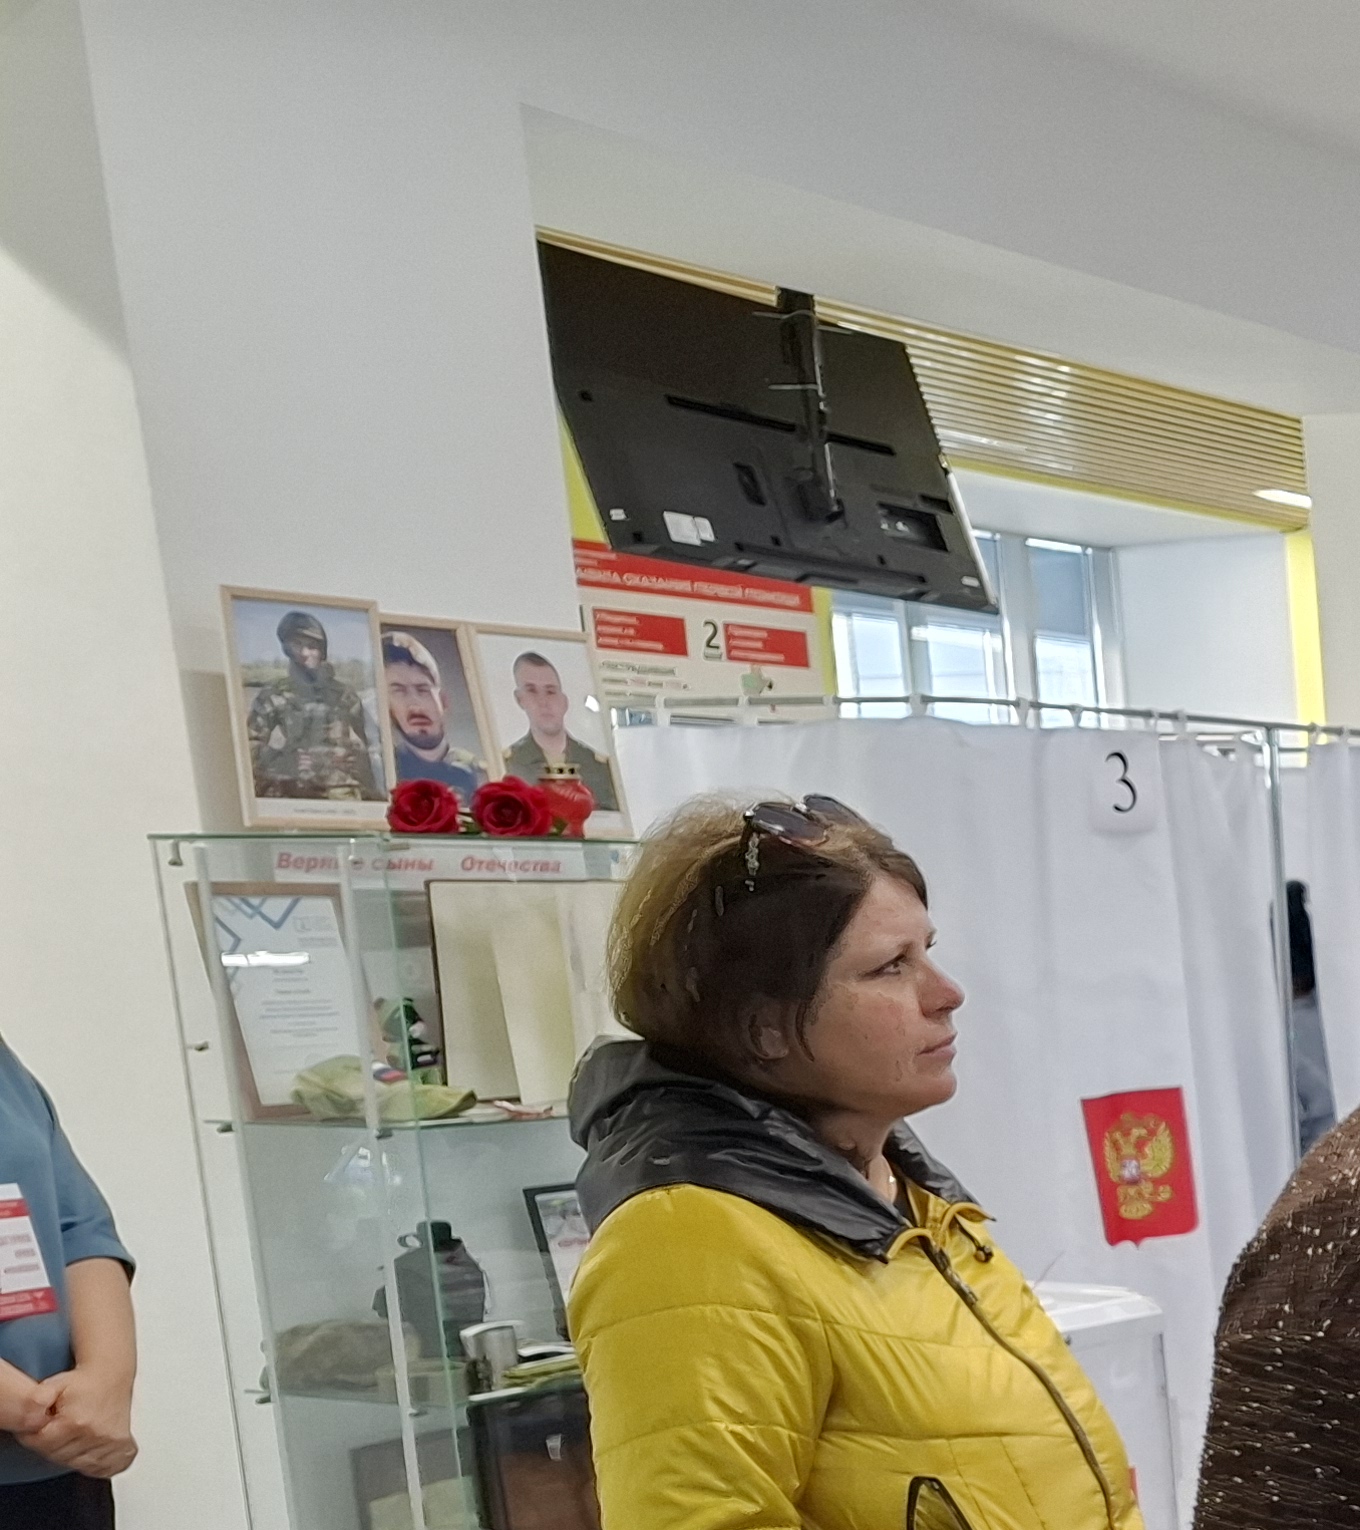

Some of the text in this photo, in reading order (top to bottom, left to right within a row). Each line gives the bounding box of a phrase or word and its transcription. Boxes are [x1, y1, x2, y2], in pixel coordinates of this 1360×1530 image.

[703, 620, 720, 649] 2
[1104, 750, 1137, 814] 3
[276, 852, 562, 874] Верне сыны Отечества
